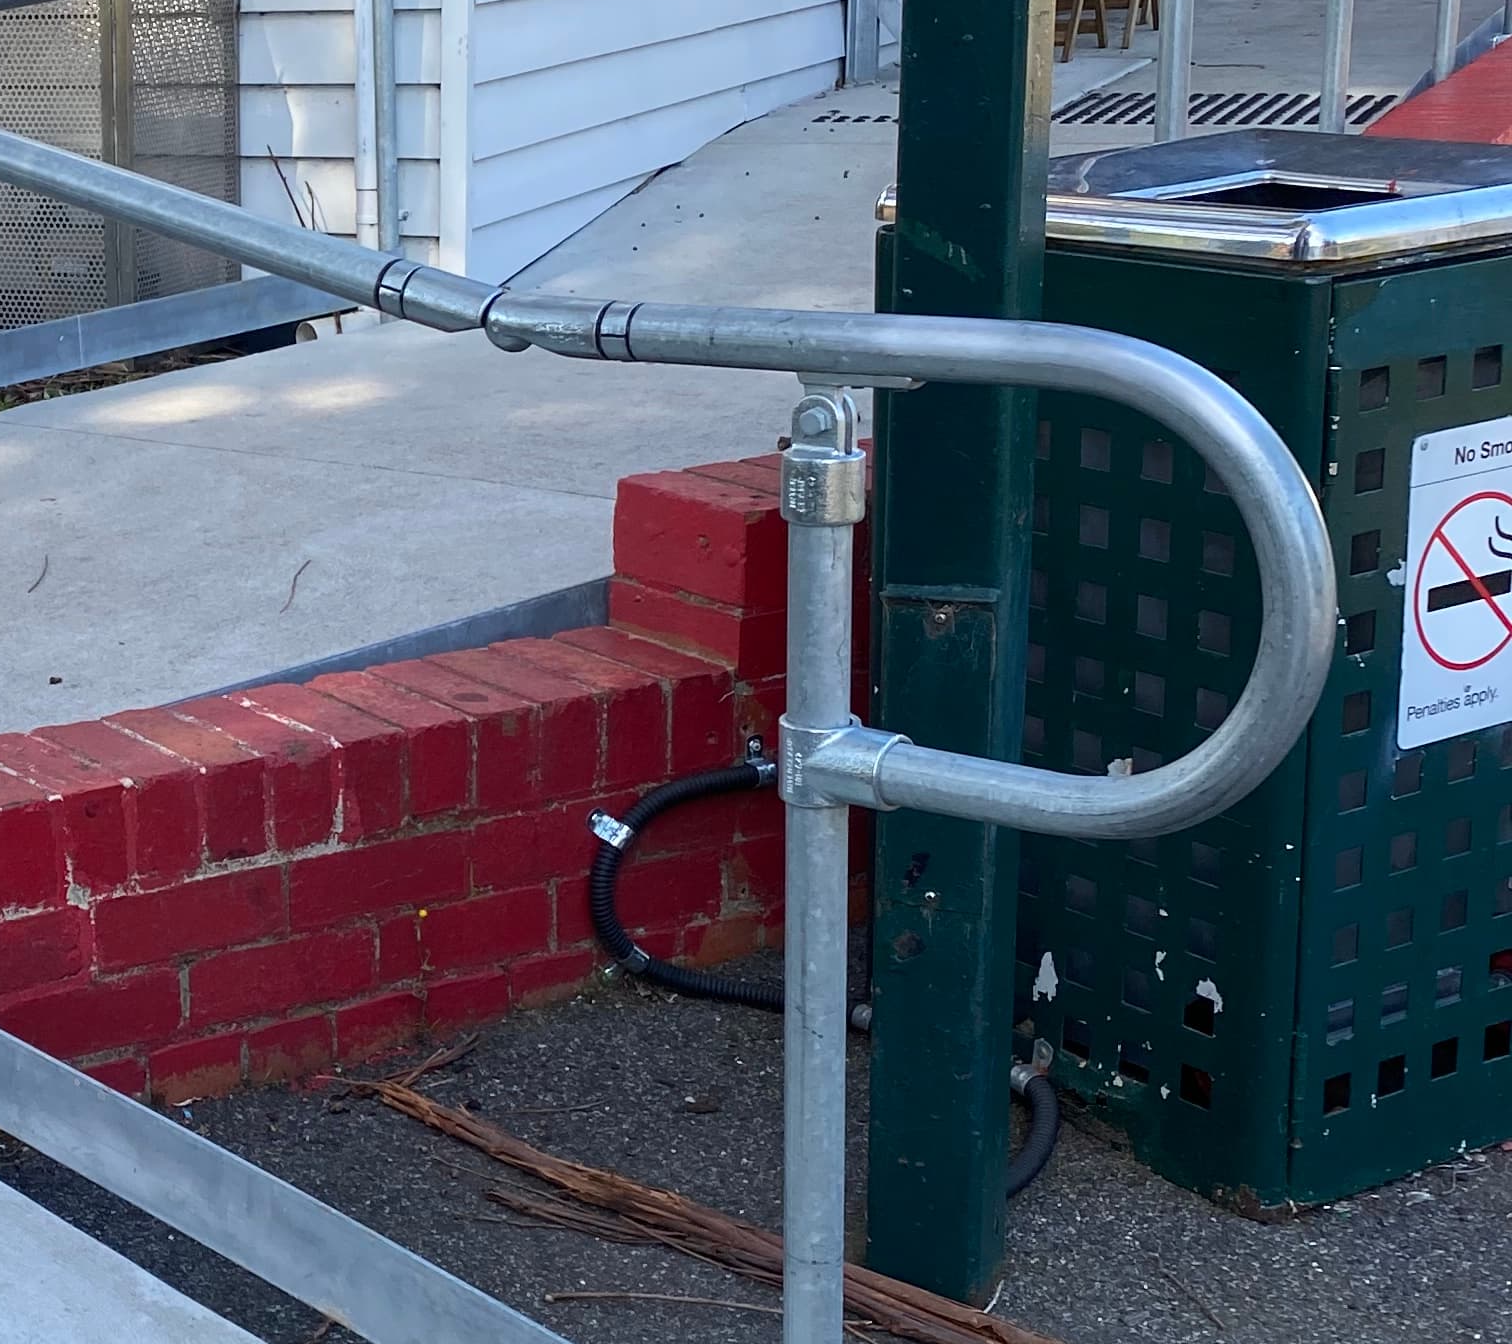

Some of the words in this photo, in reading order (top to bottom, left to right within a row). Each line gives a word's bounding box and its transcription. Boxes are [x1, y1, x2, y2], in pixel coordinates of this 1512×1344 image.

[1454, 445, 1476, 465] No
[1406, 696, 1461, 722] Penalties
[1463, 685, 1500, 709] apply.
